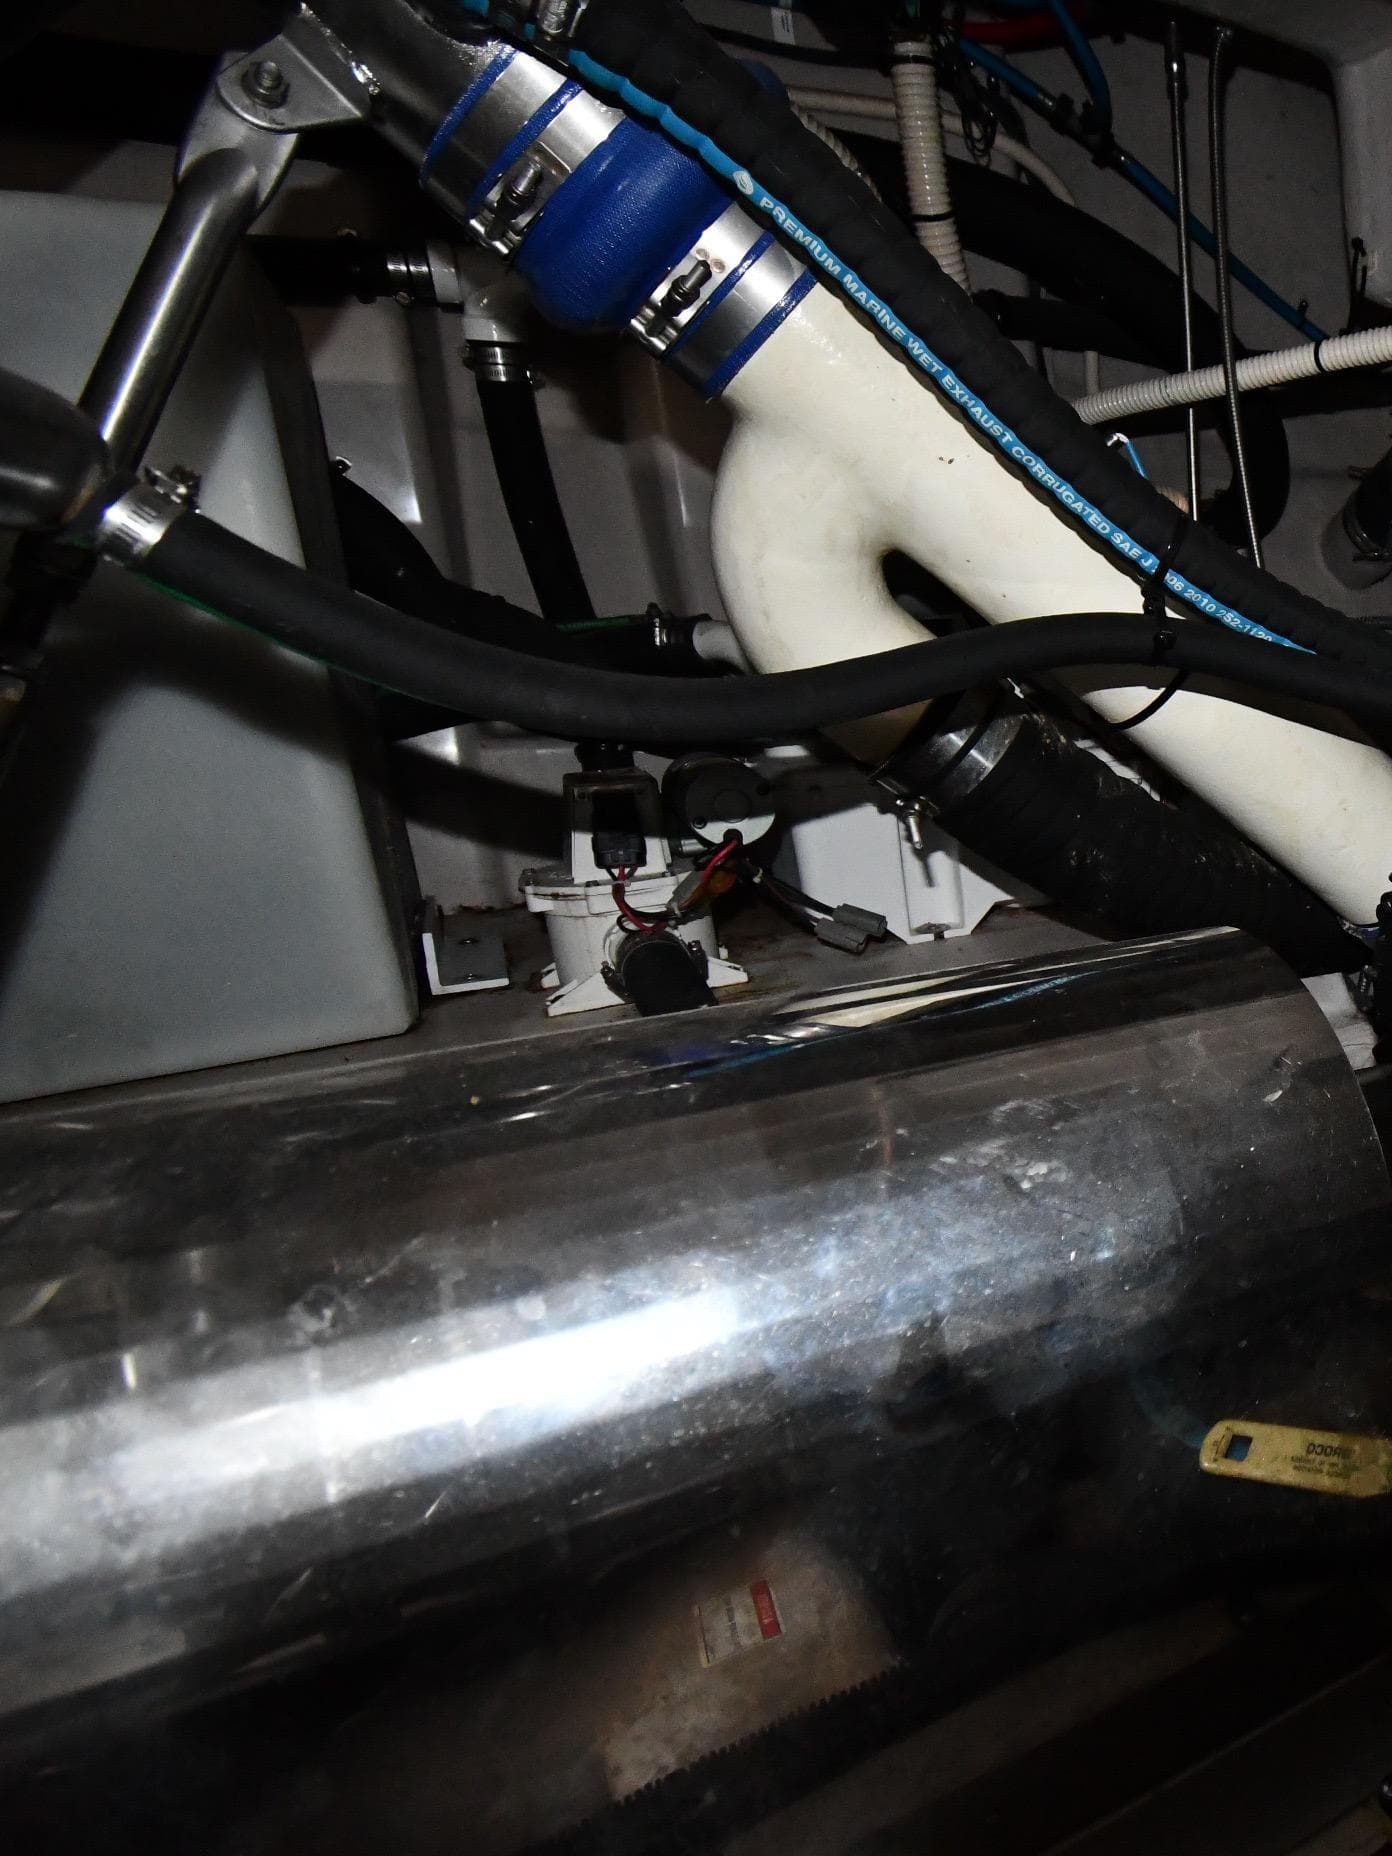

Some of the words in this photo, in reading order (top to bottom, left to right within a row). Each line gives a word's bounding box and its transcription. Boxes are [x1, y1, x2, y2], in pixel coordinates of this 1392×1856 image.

[759, 197, 842, 275] PREMIUM
[843, 274, 906, 340] MARINE
[907, 338, 943, 374] WET
[942, 374, 1013, 444] EXHAUST
[1012, 446, 1110, 534] CORRUGATED
[1111, 532, 1142, 559] SAE
[1183, 589, 1217, 613] 2010
